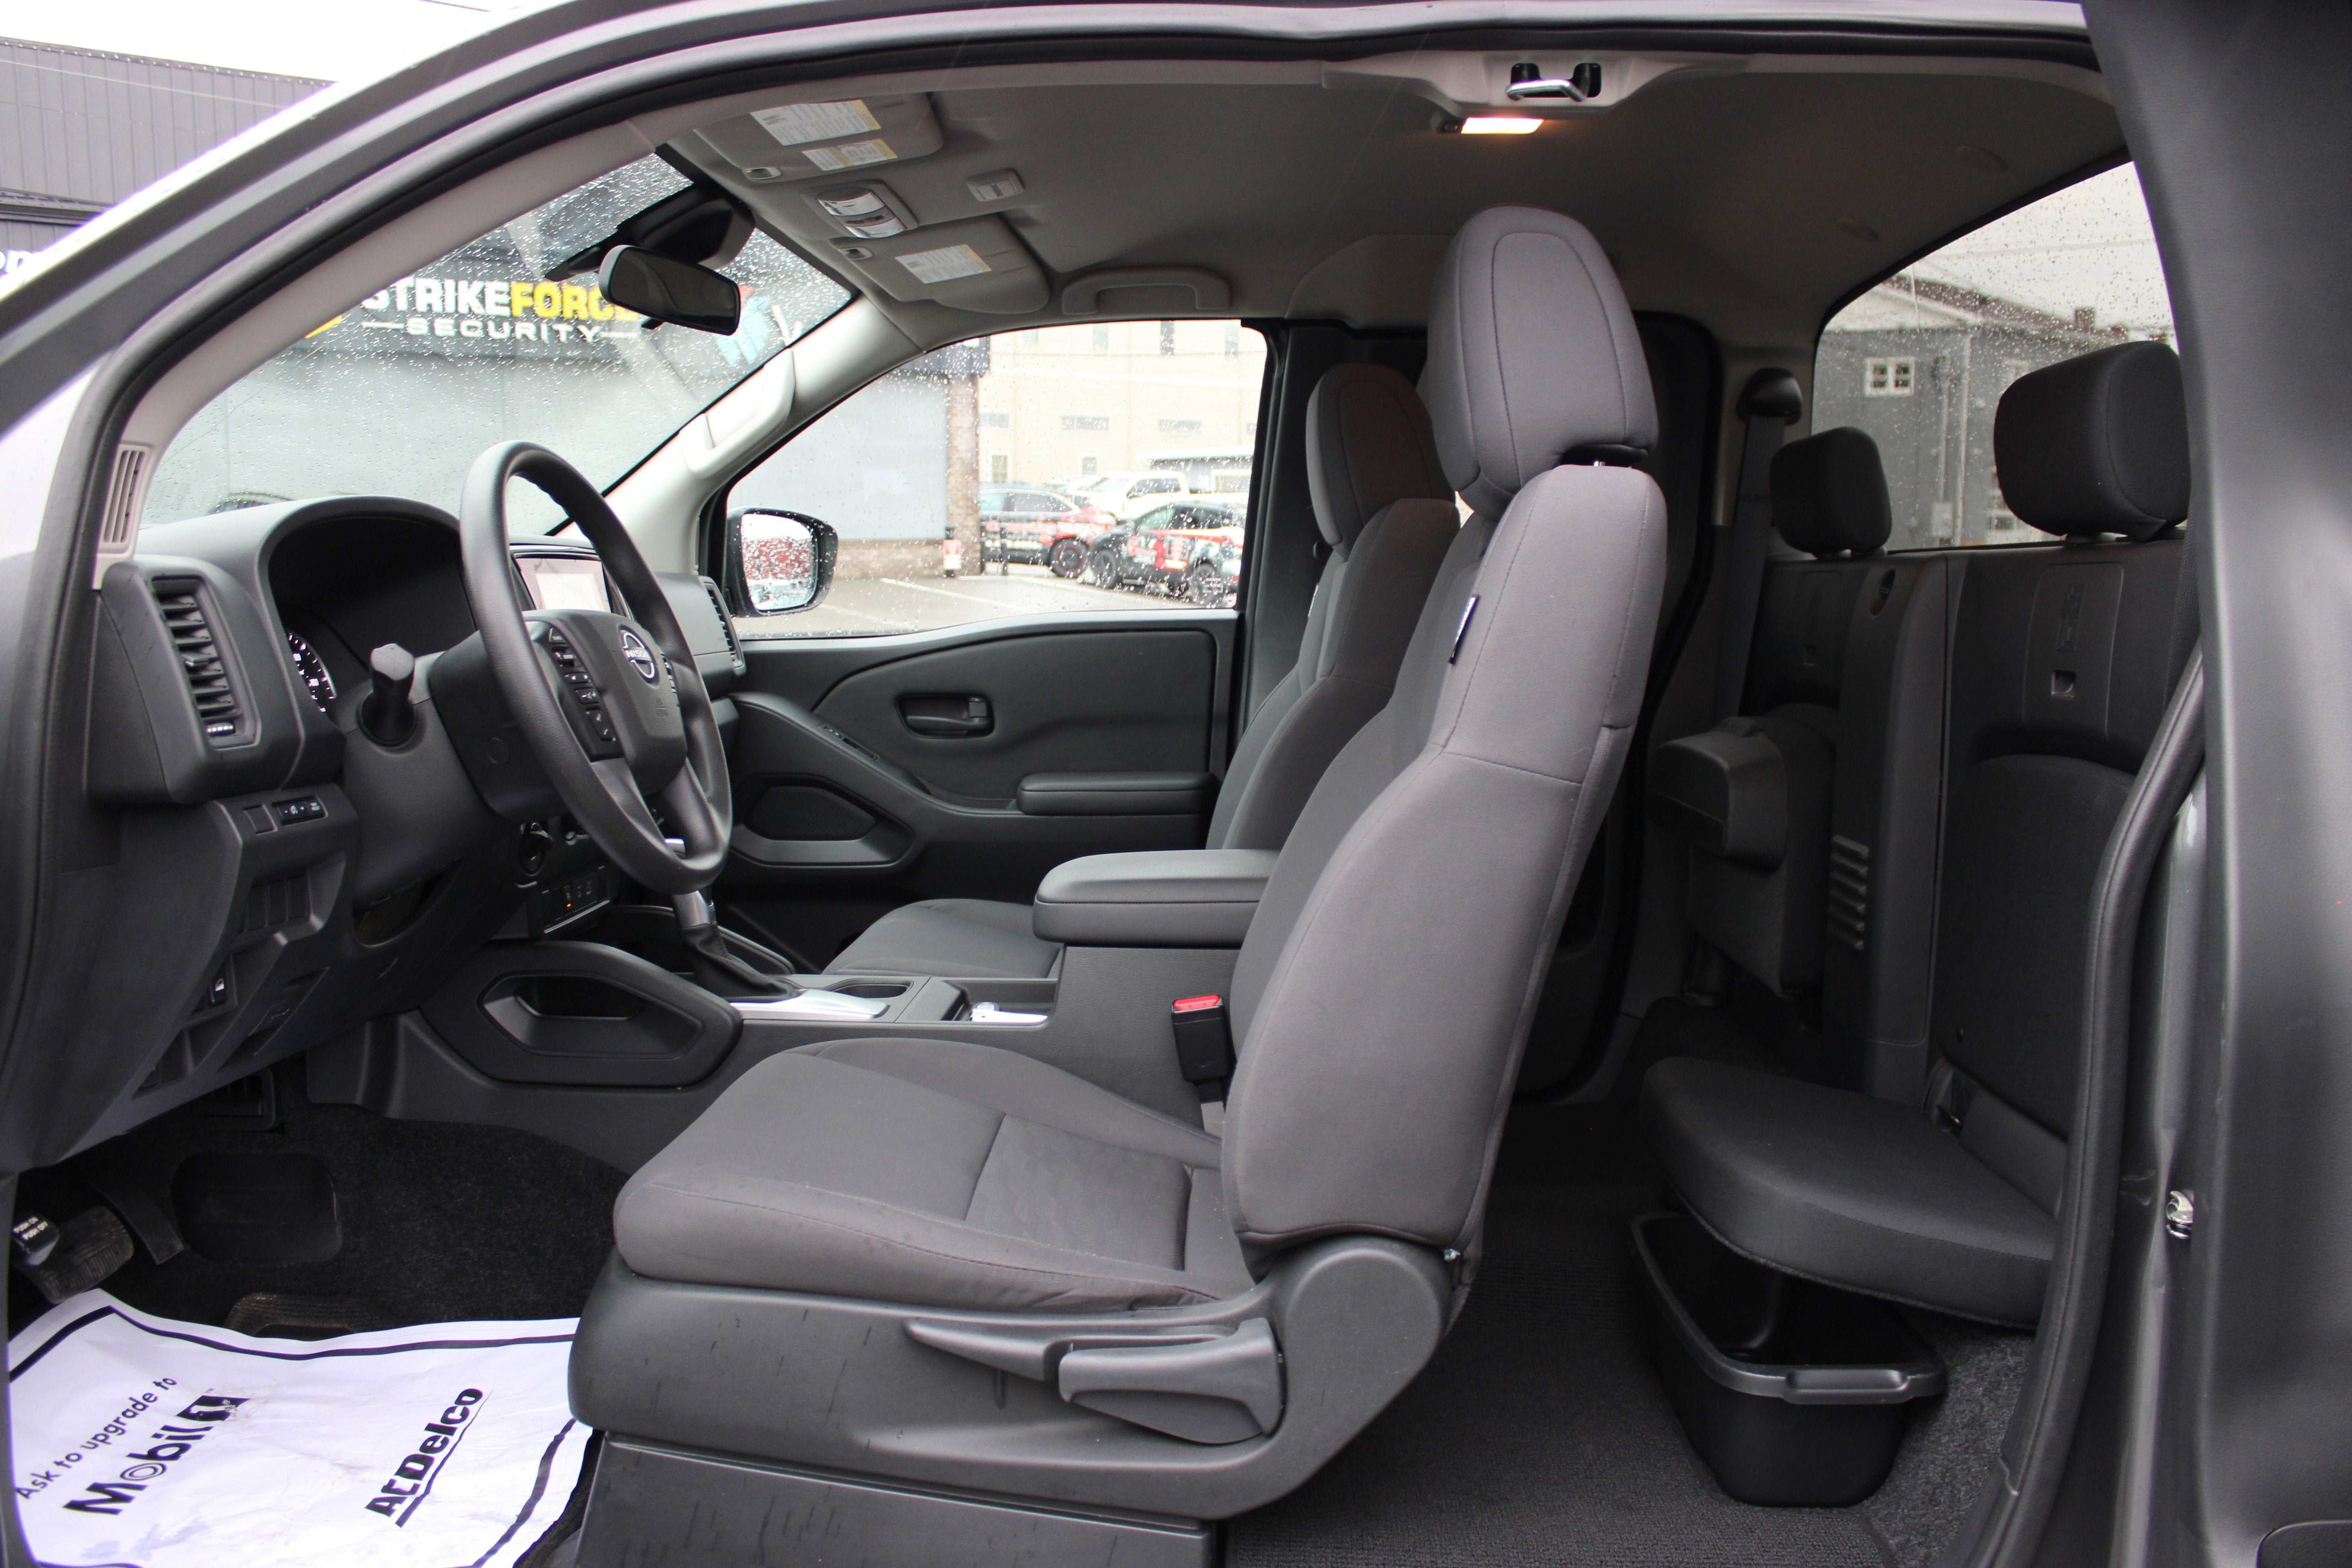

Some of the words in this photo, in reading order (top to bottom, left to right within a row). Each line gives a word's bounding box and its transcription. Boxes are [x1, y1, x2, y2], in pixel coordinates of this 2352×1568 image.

[406, 316, 602, 343] SECURITY
[15, 1470, 62, 1499] Ask
[53, 1452, 83, 1469] to
[79, 1392, 158, 1450] upgrade
[153, 1377, 178, 1390] to
[62, 1425, 215, 1515] Mobil
